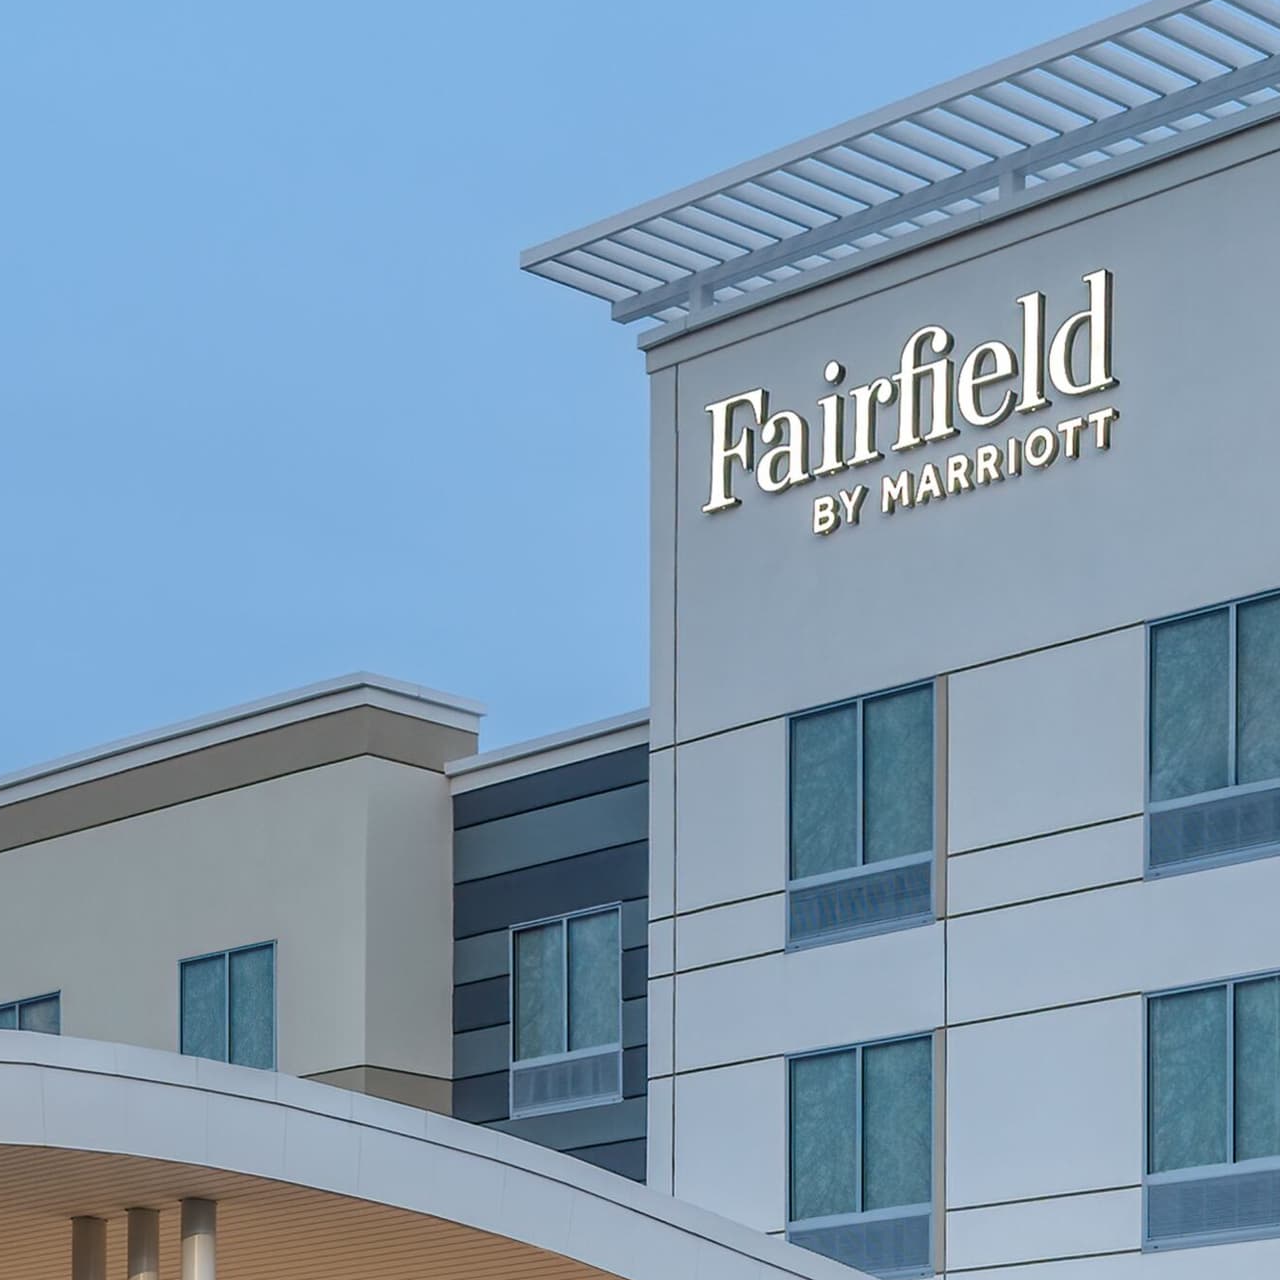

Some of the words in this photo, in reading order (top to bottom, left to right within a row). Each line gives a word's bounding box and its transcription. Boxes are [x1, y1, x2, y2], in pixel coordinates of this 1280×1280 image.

[702, 269, 1119, 513] Fairfield
[812, 484, 869, 535] BY
[880, 407, 1120, 514] MARRIOTT
